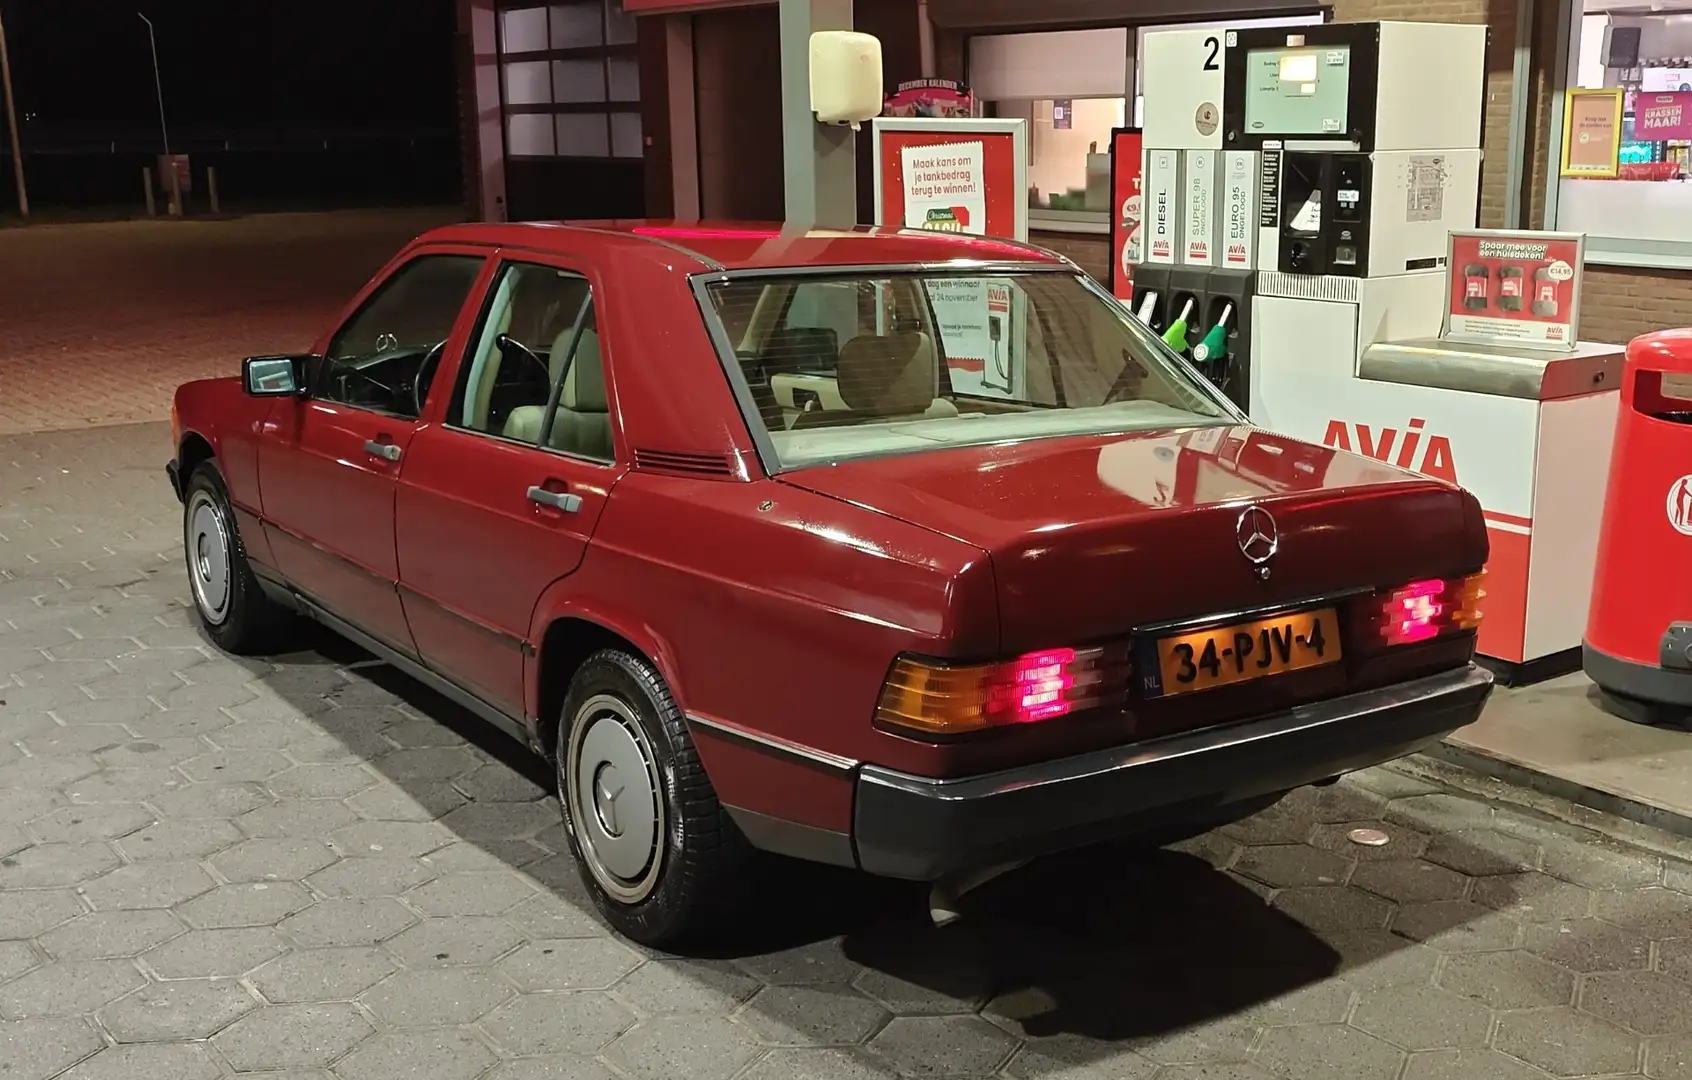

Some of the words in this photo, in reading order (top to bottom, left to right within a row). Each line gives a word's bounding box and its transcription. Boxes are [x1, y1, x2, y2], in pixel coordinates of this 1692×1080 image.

[1203, 36, 1219, 71] 2
[1644, 115, 1681, 128] MAAR!
[912, 158, 935, 169] Maak
[936, 156, 957, 168] kans
[957, 156, 972, 166] om
[914, 171, 922, 185] je
[923, 170, 971, 182] tankbedrag
[1193, 178, 1201, 191] 98
[911, 186, 933, 198] terug
[934, 185, 942, 194] te
[942, 182, 976, 194] winnen!
[1232, 186, 1240, 200] 95
[1157, 188, 1167, 235] DIESEL
[1192, 197, 1200, 236] SUPER
[1230, 204, 1240, 239] EURO
[1479, 241, 1506, 251] Spaar
[1527, 244, 1547, 252] voor
[936, 293, 945, 301] 24
[945, 293, 978, 301] november
[1173, 618, 1326, 684] 34-PJV-4
[1144, 677, 1160, 690] NL
